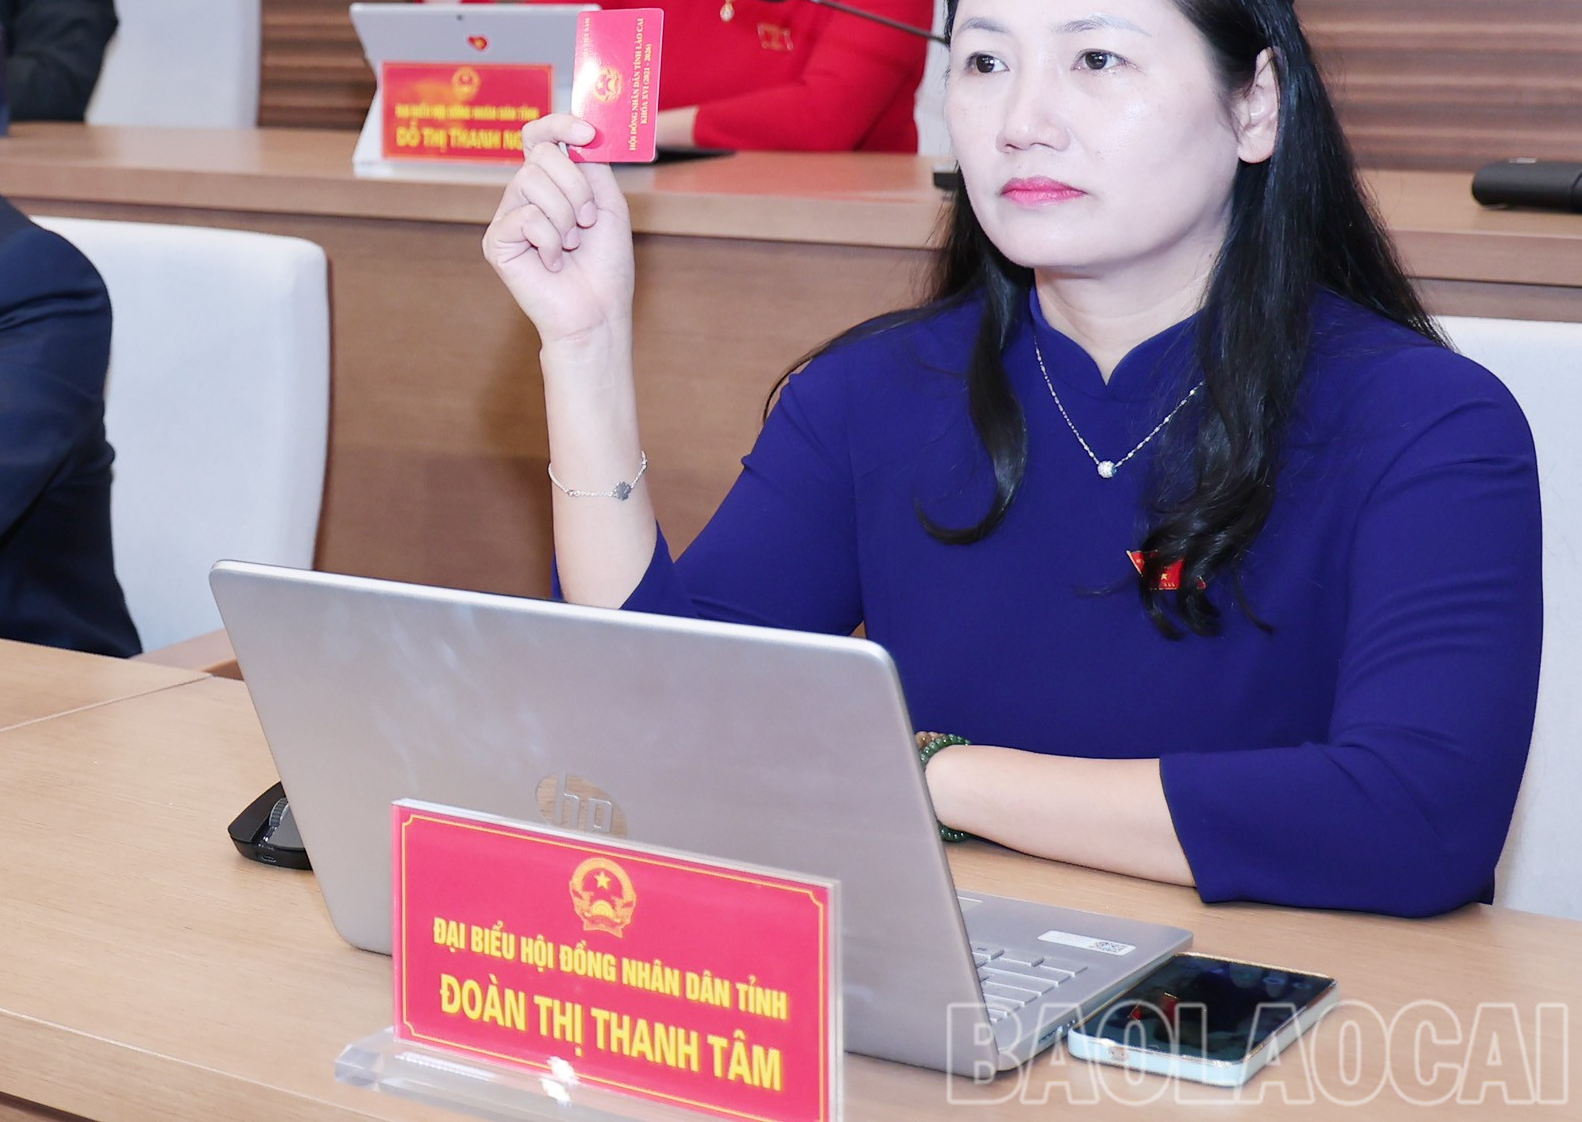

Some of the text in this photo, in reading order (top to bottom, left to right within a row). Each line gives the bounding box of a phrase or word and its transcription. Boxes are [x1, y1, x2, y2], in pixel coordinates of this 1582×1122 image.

[636, 18, 644, 32] CAI
[634, 33, 643, 50] LÀO
[644, 44, 652, 61] 2026)
[632, 71, 640, 87] DÂN
[631, 89, 640, 110] NHÂN
[642, 86, 650, 100] XVI
[640, 101, 649, 124] KHÓA
[628, 111, 638, 134] ĐỒNG
[628, 135, 637, 150] HỘI
[433, 917, 787, 1020] ĐẠI BIỂU HỘI ĐỒNG NHÂN DÂN TỈNH
[439, 973, 781, 1091] ĐOÀN THỊ THANH TÂM
